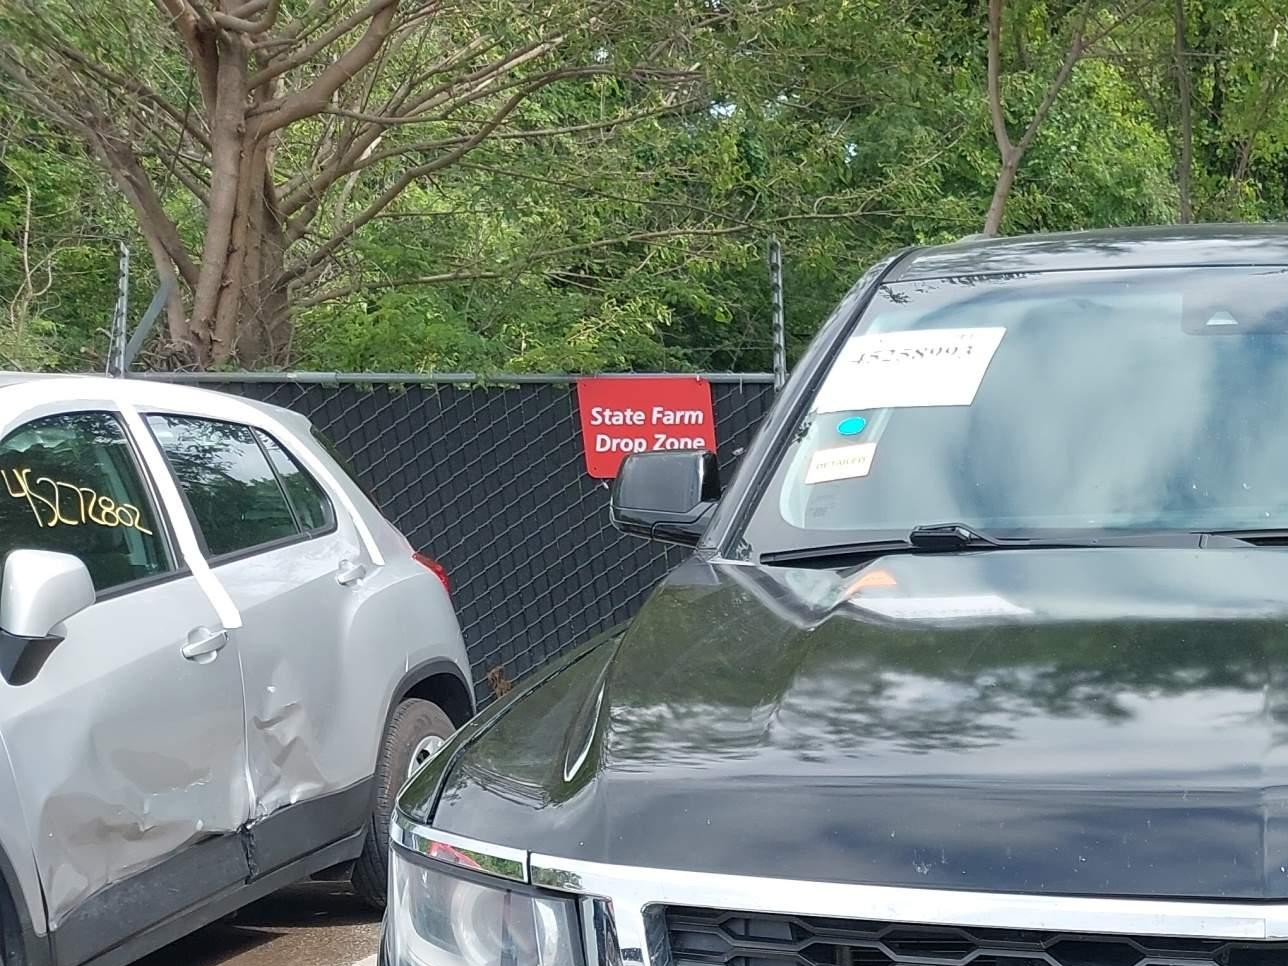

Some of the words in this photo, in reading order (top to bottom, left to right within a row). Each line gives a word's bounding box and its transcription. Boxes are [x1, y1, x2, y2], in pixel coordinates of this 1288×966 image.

[591, 407, 645, 425] State
[652, 406, 704, 425] Farm
[595, 434, 647, 453] Drop
[653, 434, 706, 451] Zone
[0, 468, 153, 535] 45272802
